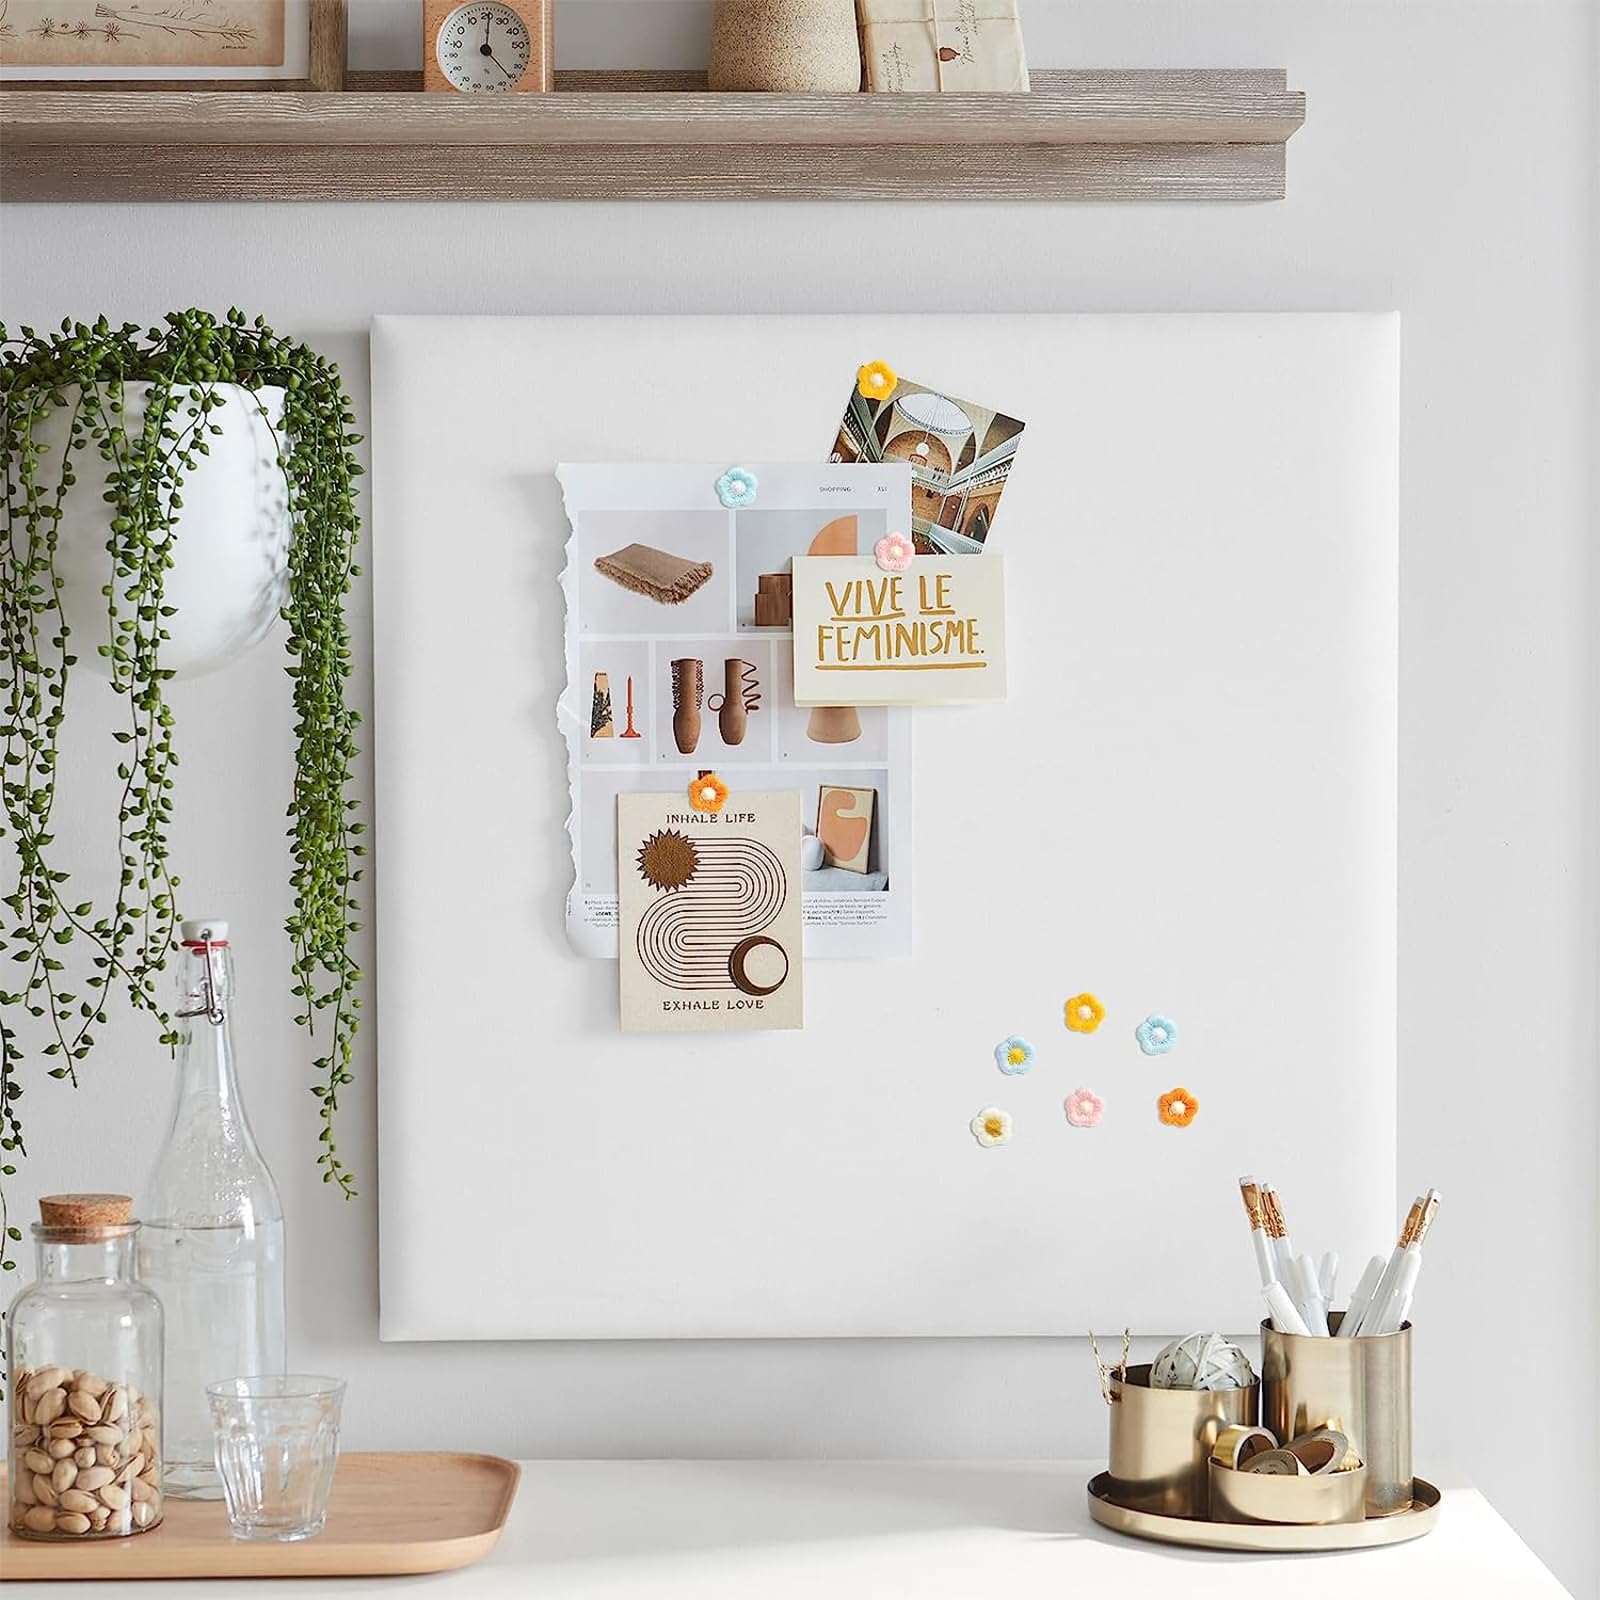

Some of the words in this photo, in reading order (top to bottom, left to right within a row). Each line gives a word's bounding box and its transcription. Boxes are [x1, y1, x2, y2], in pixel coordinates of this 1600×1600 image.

[468, 17, 477, 25] 10
[481, 12, 493, 20] 20
[457, 26, 465, 35] 0
[512, 41, 525, 49] 50
[825, 576, 903, 616] VIVE
[919, 575, 952, 610] LE
[817, 618, 984, 662] FEMINISME.
[666, 813, 718, 824] INHALE
[725, 813, 756, 823] LIFE
[663, 1000, 719, 1010] EXHALE
[727, 999, 764, 1010] LOVE
